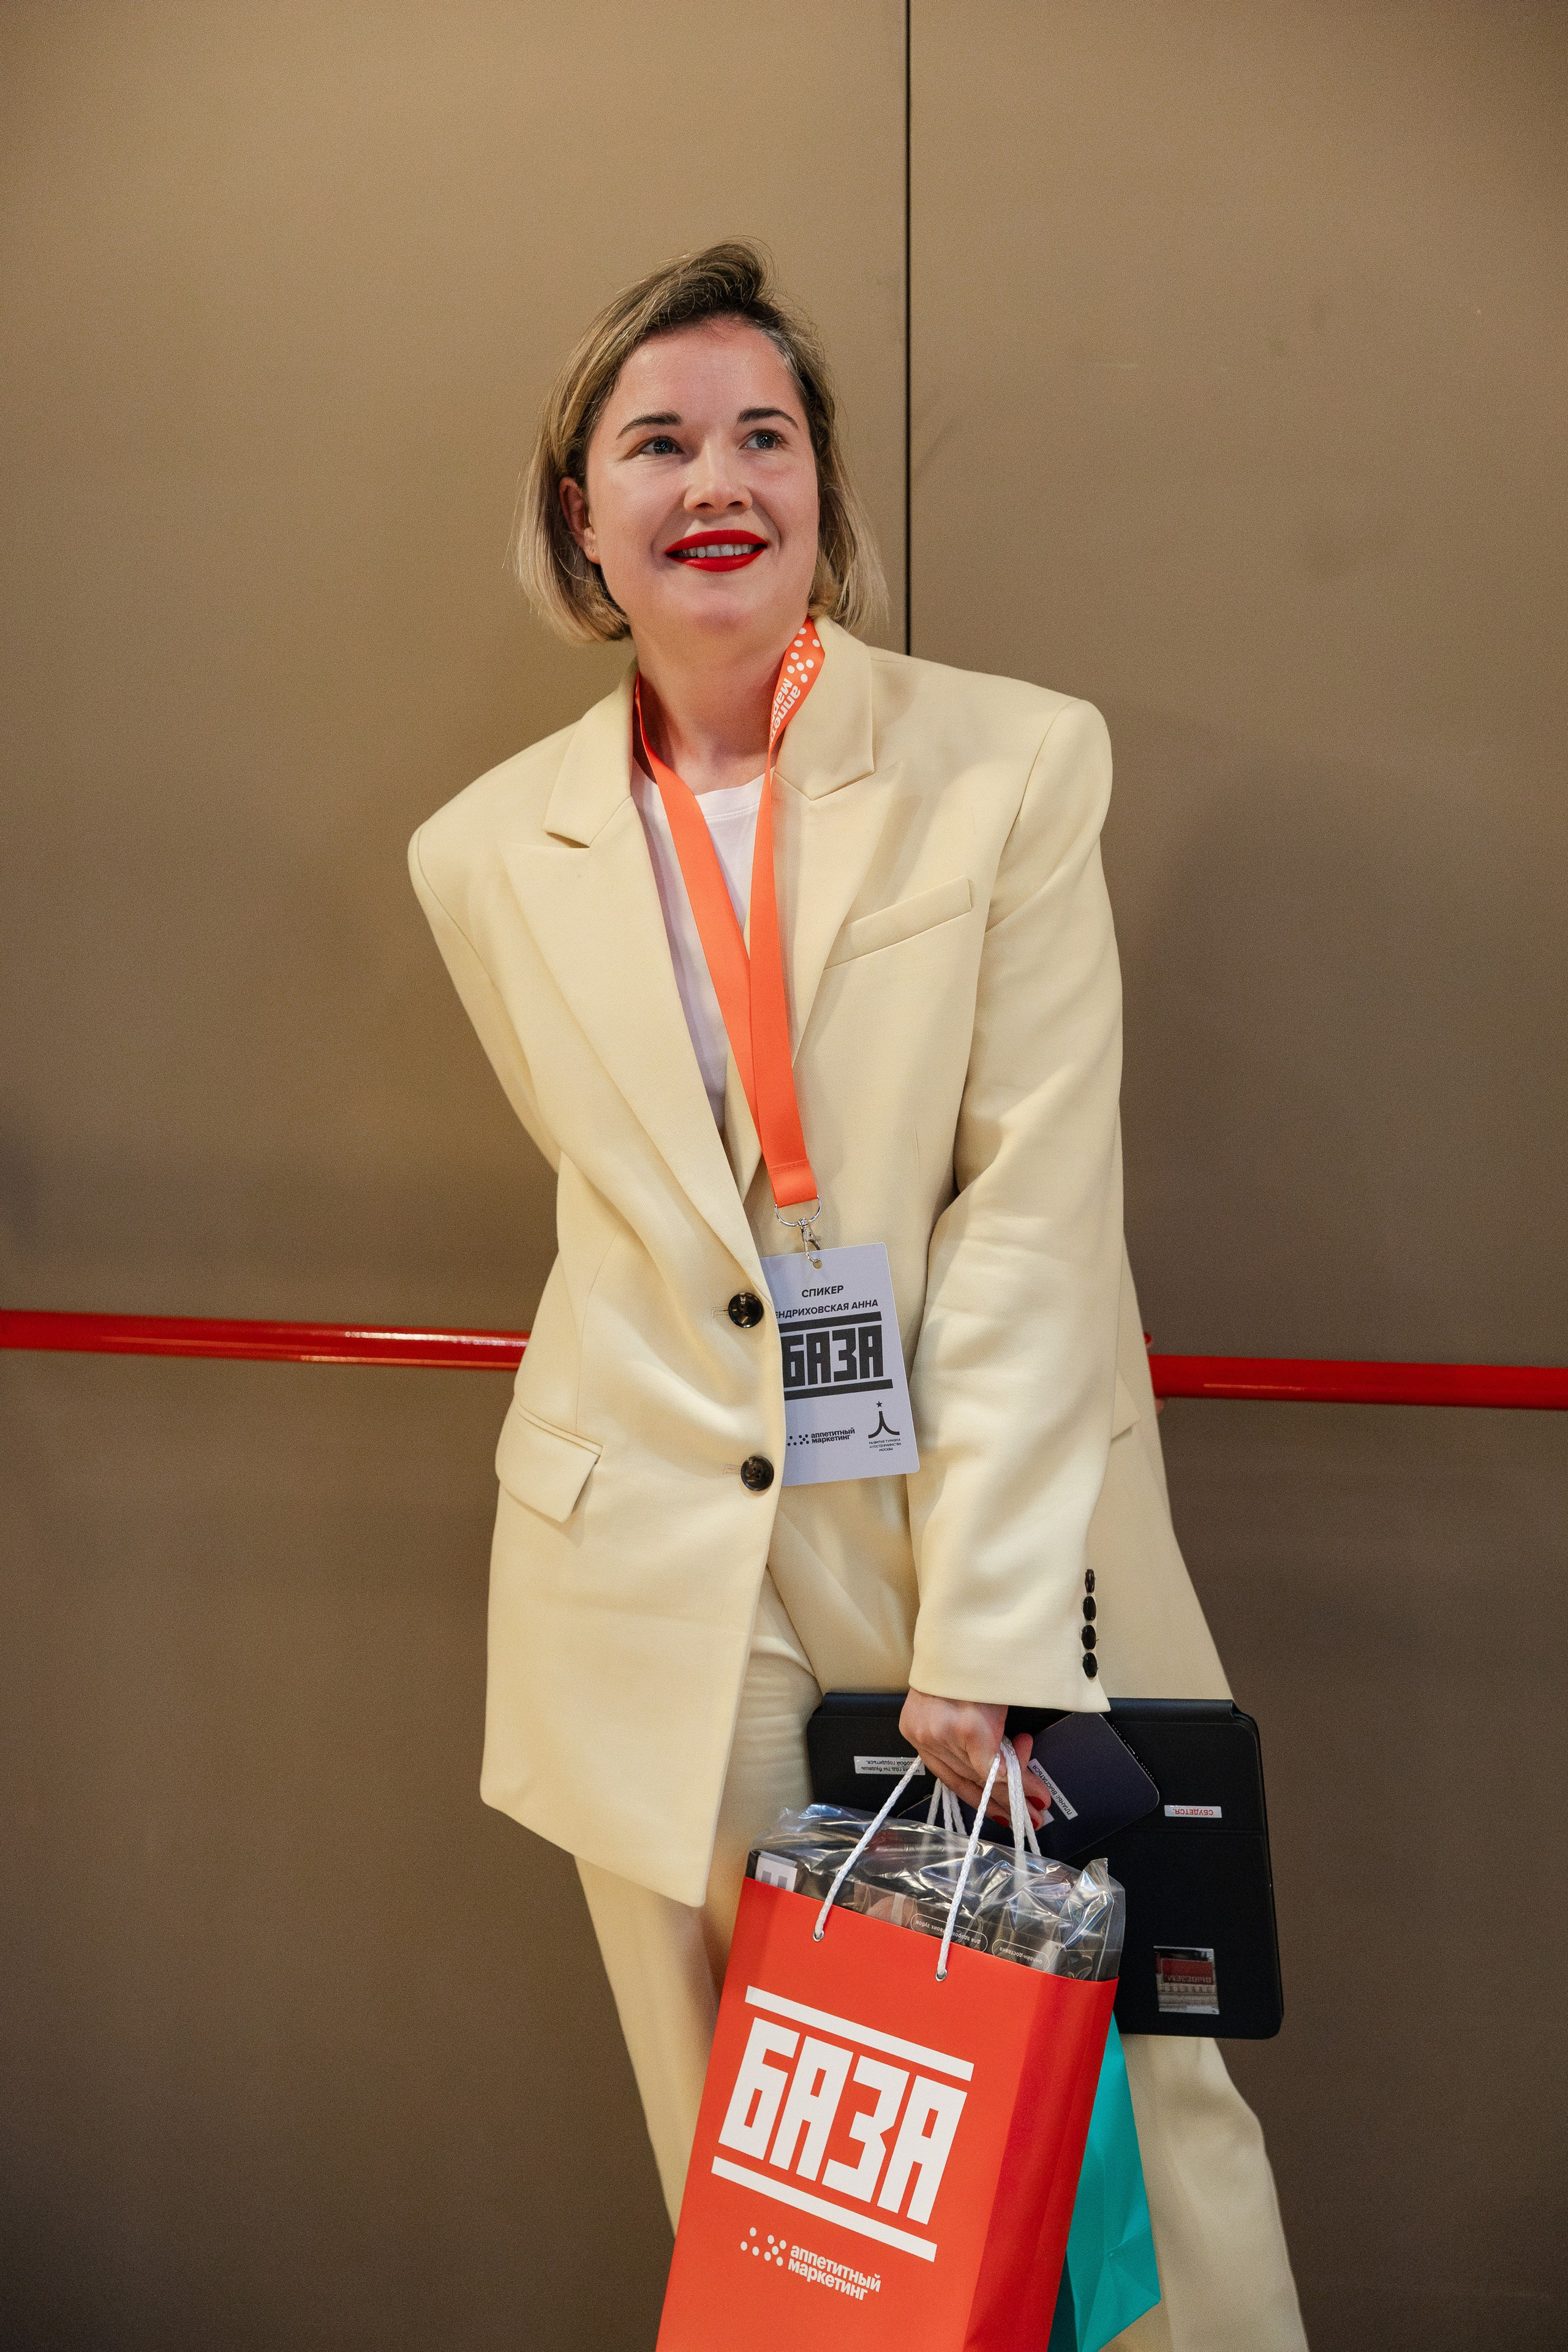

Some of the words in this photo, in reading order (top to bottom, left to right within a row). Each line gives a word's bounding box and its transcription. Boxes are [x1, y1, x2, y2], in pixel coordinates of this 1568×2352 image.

[802, 1285, 844, 1297] СПИКЕР
[851, 1299, 878, 1310] АННА
[780, 1324, 884, 1389] БАЗА
[811, 1427, 856, 1439] аппетитный
[812, 1434, 850, 1444] маркетинг
[1033, 1763, 1058, 1795] ВЫСПАТЬСЯ.
[1057, 1795, 1072, 1815] ПЛАНЫ:
[718, 2017, 968, 2225] БАЗА
[788, 2258, 868, 2301] маркетинг
[790, 2245, 881, 2293] аппетитный
